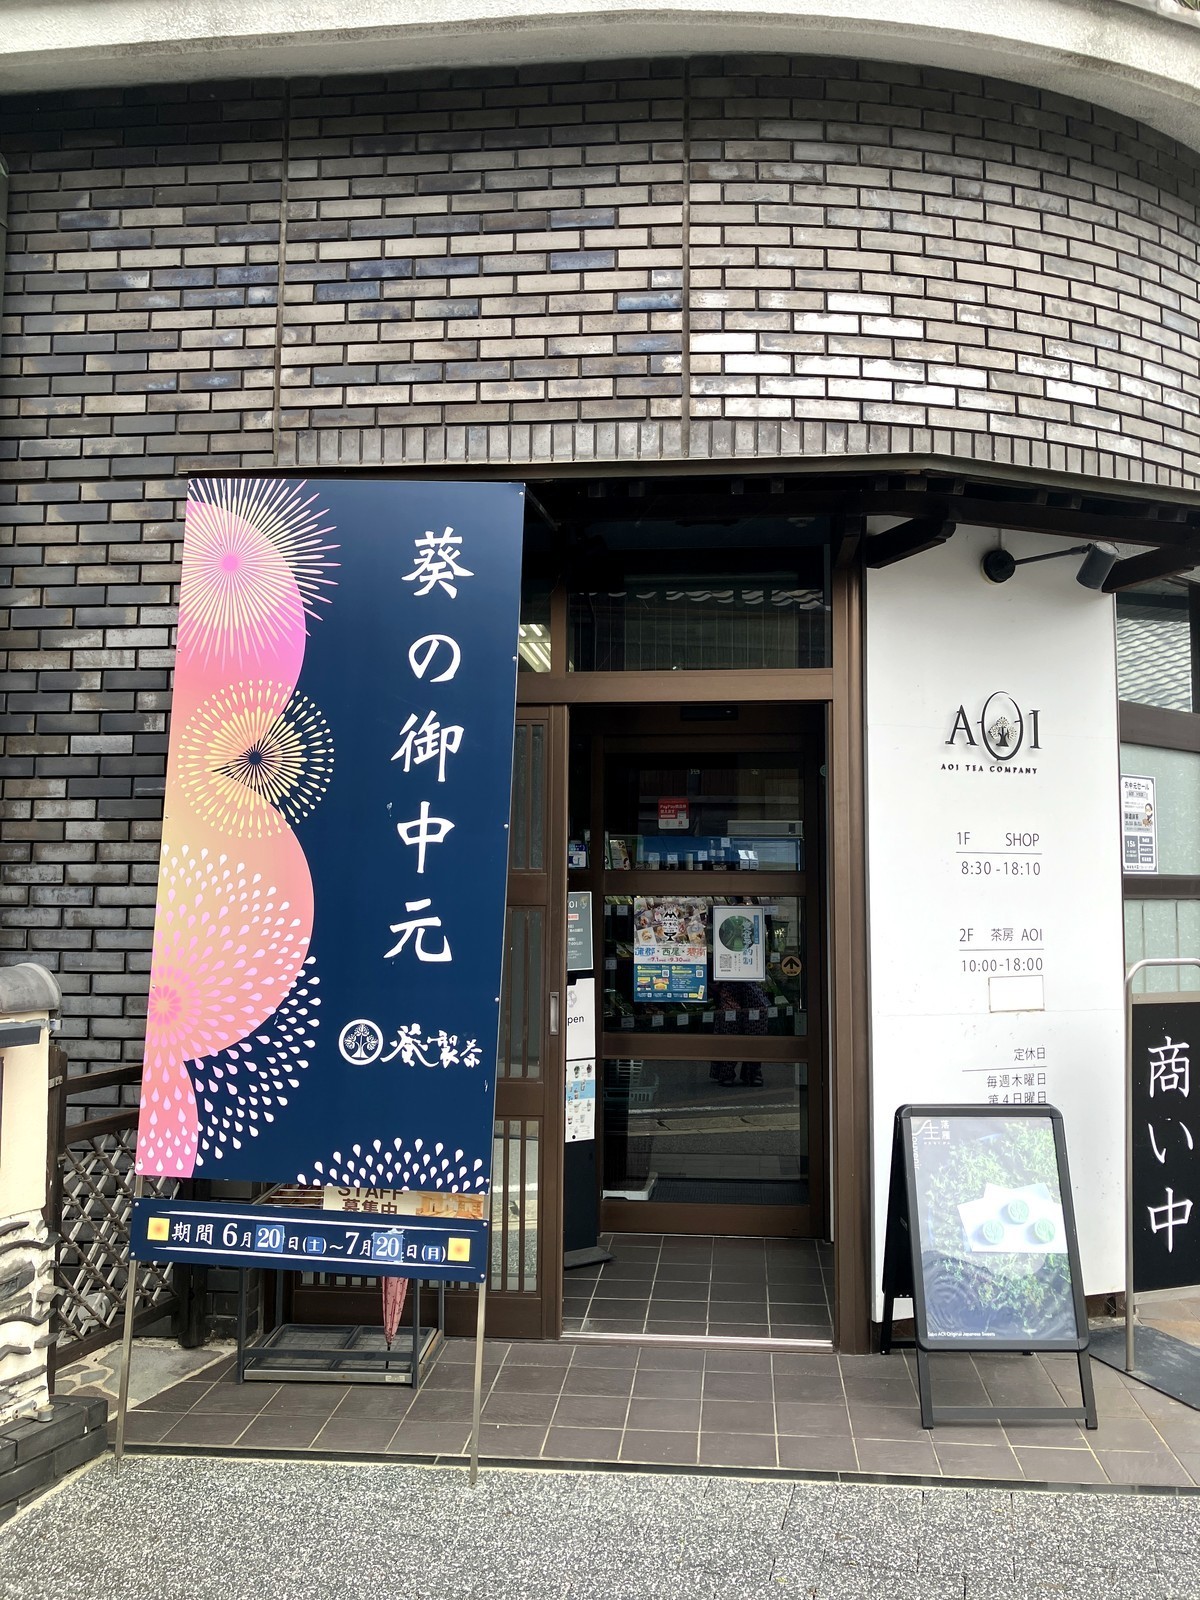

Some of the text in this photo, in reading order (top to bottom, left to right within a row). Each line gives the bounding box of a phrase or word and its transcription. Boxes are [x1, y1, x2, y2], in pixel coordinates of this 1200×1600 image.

[945, 691, 1042, 761] AOI
[384, 527, 474, 963] 葵の御中元
[989, 766, 1038, 774] COMPANY
[957, 832, 1040, 847] 1F SHOP
[568, 900, 578, 908] OI
[959, 928, 1043, 942] 2F 茶房 AOI
[961, 957, 1043, 972] 10:00-18:00
[567, 1015, 585, 1026] pen
[1013, 1047, 1046, 1061] 定休日
[987, 1072, 1046, 1088] 毎週木曜日
[1147, 1036, 1194, 1253] 商い中
[172, 1221, 214, 1246] 期間
